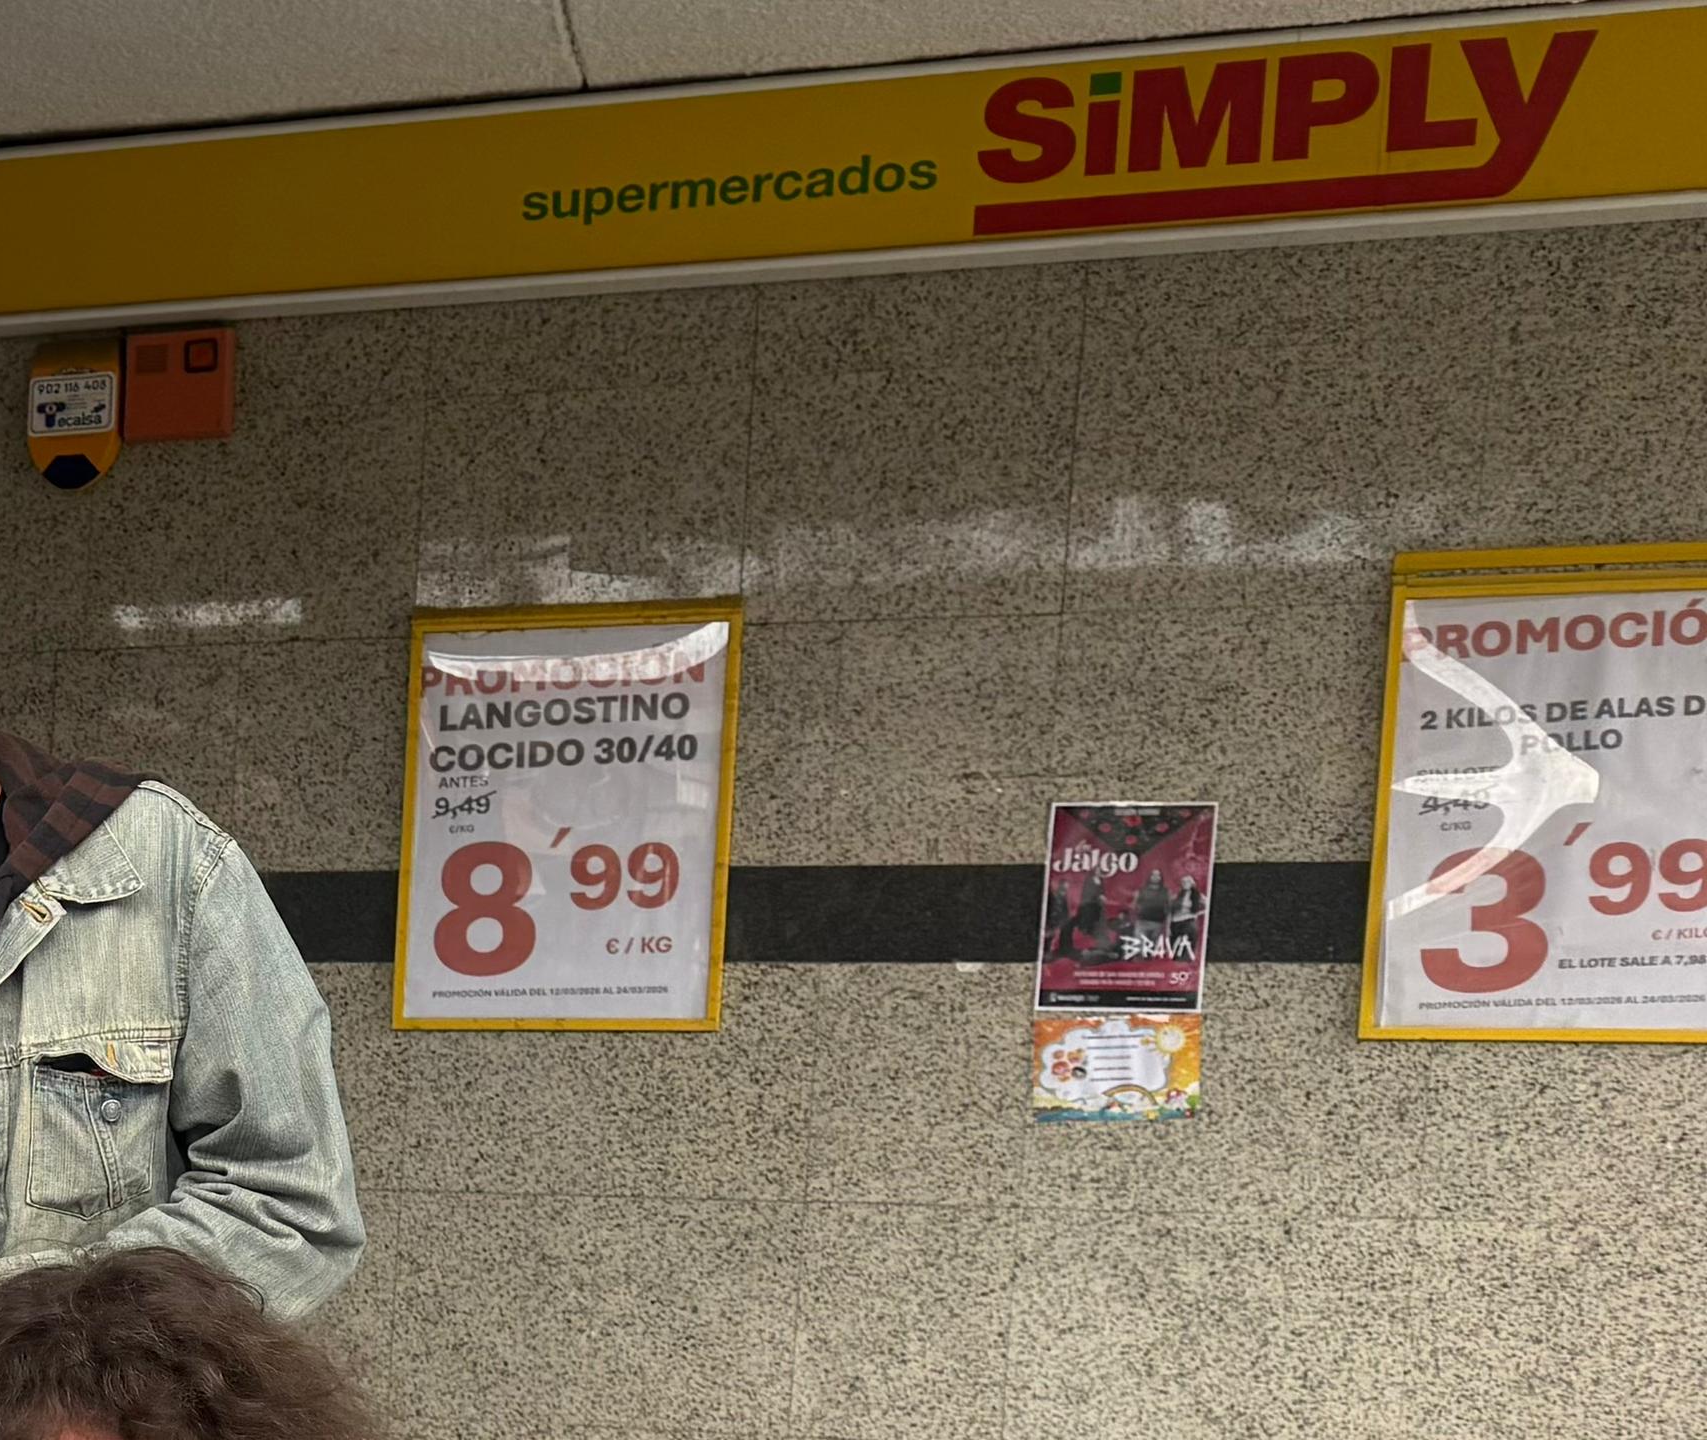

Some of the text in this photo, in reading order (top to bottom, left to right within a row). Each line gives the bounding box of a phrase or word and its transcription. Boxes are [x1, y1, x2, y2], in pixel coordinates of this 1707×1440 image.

[521, 153, 938, 227] supermercados
[438, 691, 691, 732] LANGOSTINO
[1420, 710, 1437, 730] 2
[1445, 703, 1537, 729] KILOS
[1546, 700, 1588, 723] DE
[1594, 696, 1675, 719] ALAS
[429, 734, 698, 772] COCIDO 30/40
[1521, 729, 1623, 756] POLLO
[438, 776, 489, 789] ANTES
[433, 794, 492, 819] 9,49
[641, 935, 673, 954] KG
[1558, 958, 1576, 969] EL
[1580, 957, 1616, 968] LOTE
[1620, 956, 1658, 967] SALE
[1661, 955, 1672, 965] A
